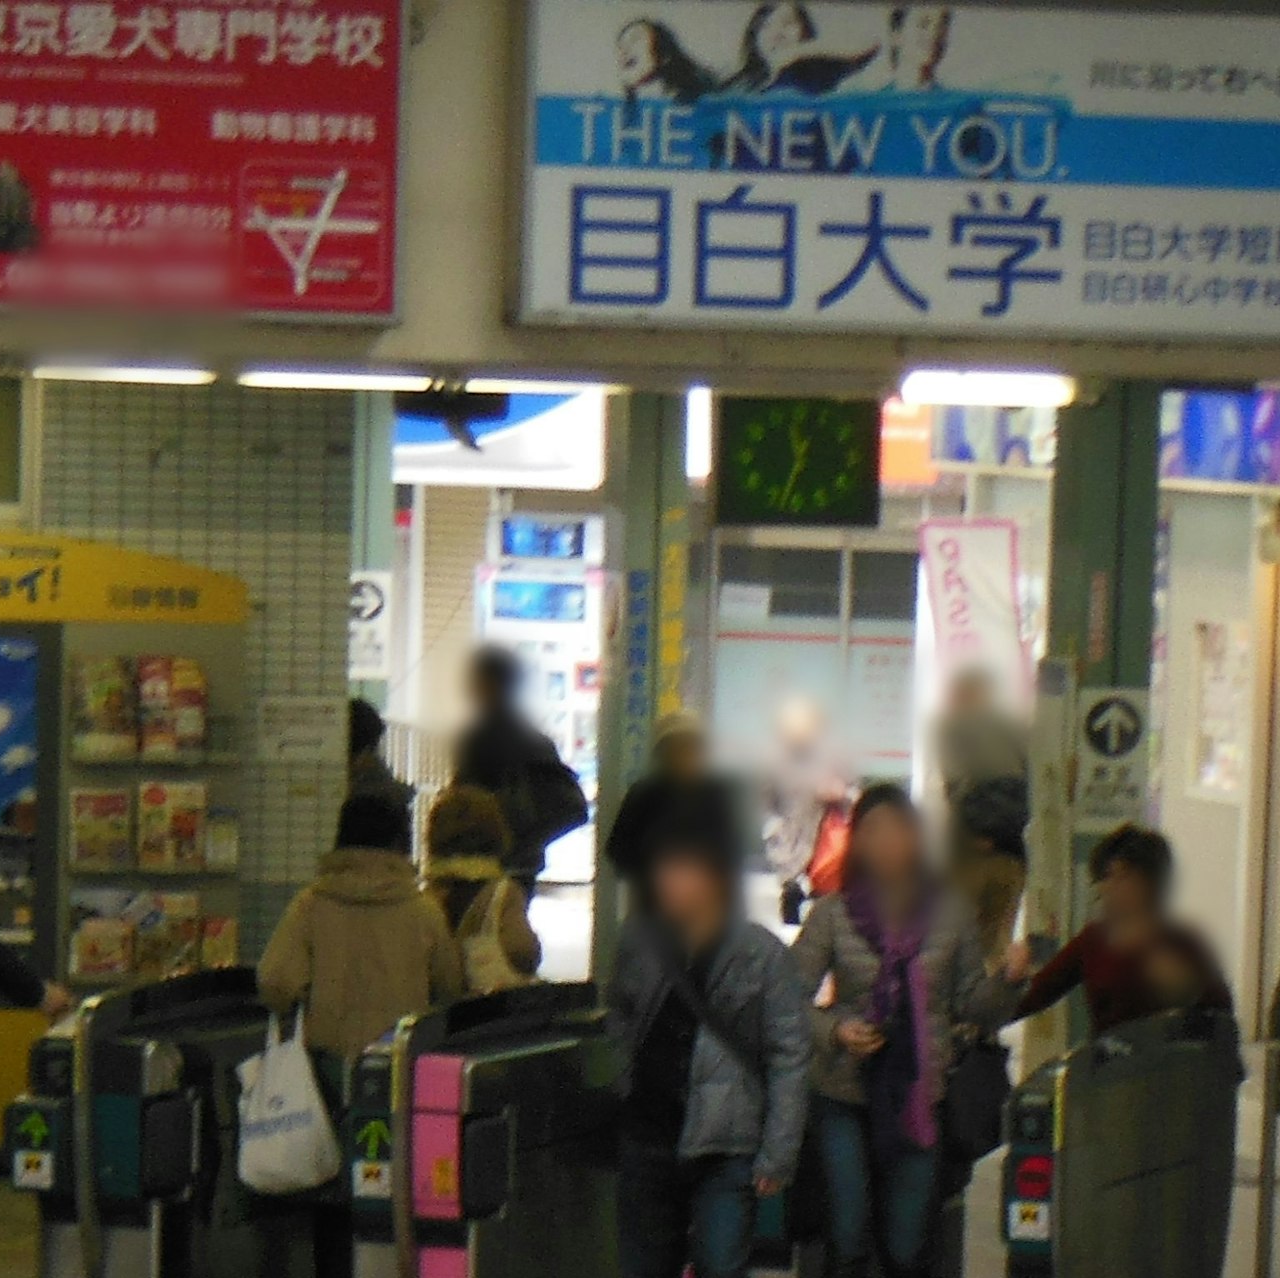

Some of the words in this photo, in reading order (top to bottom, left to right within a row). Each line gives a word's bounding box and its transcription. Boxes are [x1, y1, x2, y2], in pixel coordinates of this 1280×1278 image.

[568, 102, 694, 165] THE
[724, 109, 886, 170] NEW
[911, 113, 1070, 180] YOU.
[569, 183, 1063, 317] 目白大学
